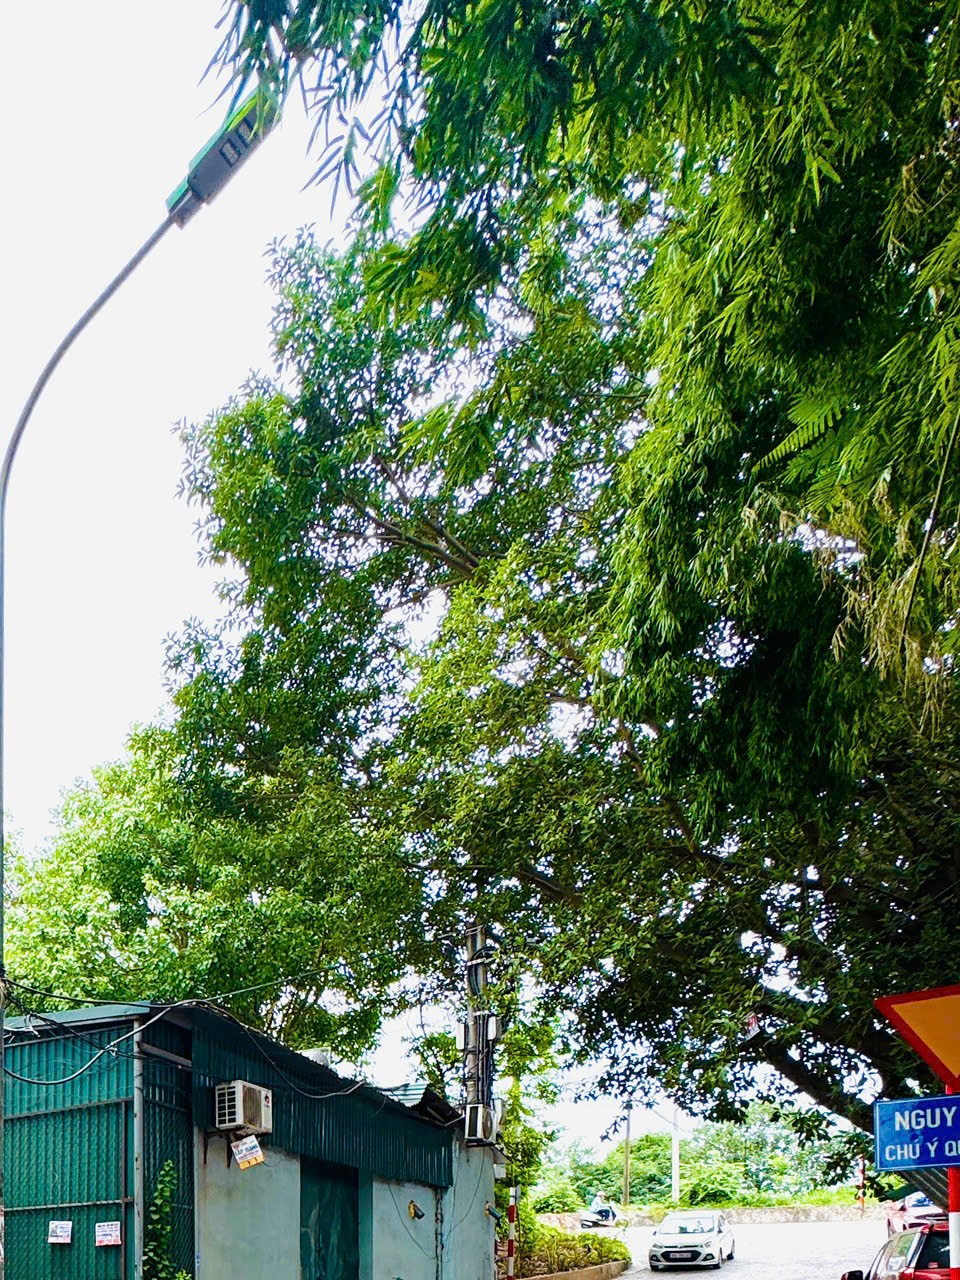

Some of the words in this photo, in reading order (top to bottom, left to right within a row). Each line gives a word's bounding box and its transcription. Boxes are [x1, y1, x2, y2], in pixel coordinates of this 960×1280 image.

[894, 1106, 958, 1131] NGUY
[885, 1138, 920, 1161] CHÚ
[926, 1136, 939, 1158] Ý
[944, 1139, 960, 1157] Q
